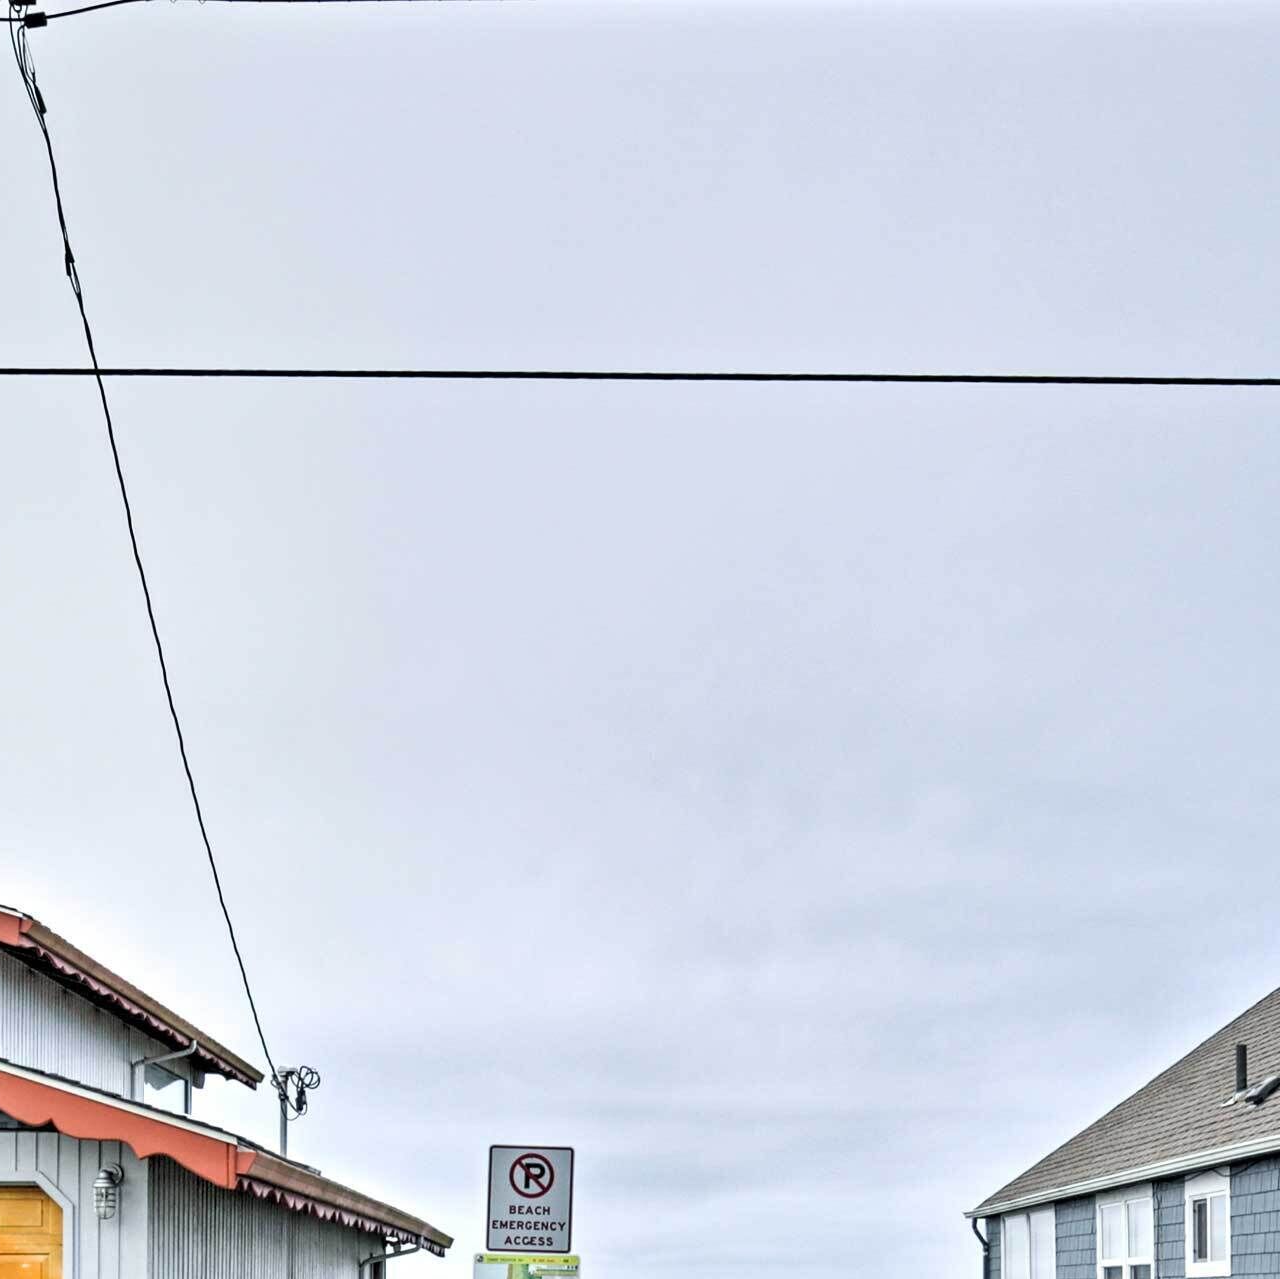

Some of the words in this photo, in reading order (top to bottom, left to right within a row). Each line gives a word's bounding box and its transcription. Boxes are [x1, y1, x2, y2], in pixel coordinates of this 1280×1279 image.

[509, 1205, 551, 1215] BEACH
[491, 1220, 566, 1231] EMERGENCY
[504, 1236, 554, 1246] ACCESS
